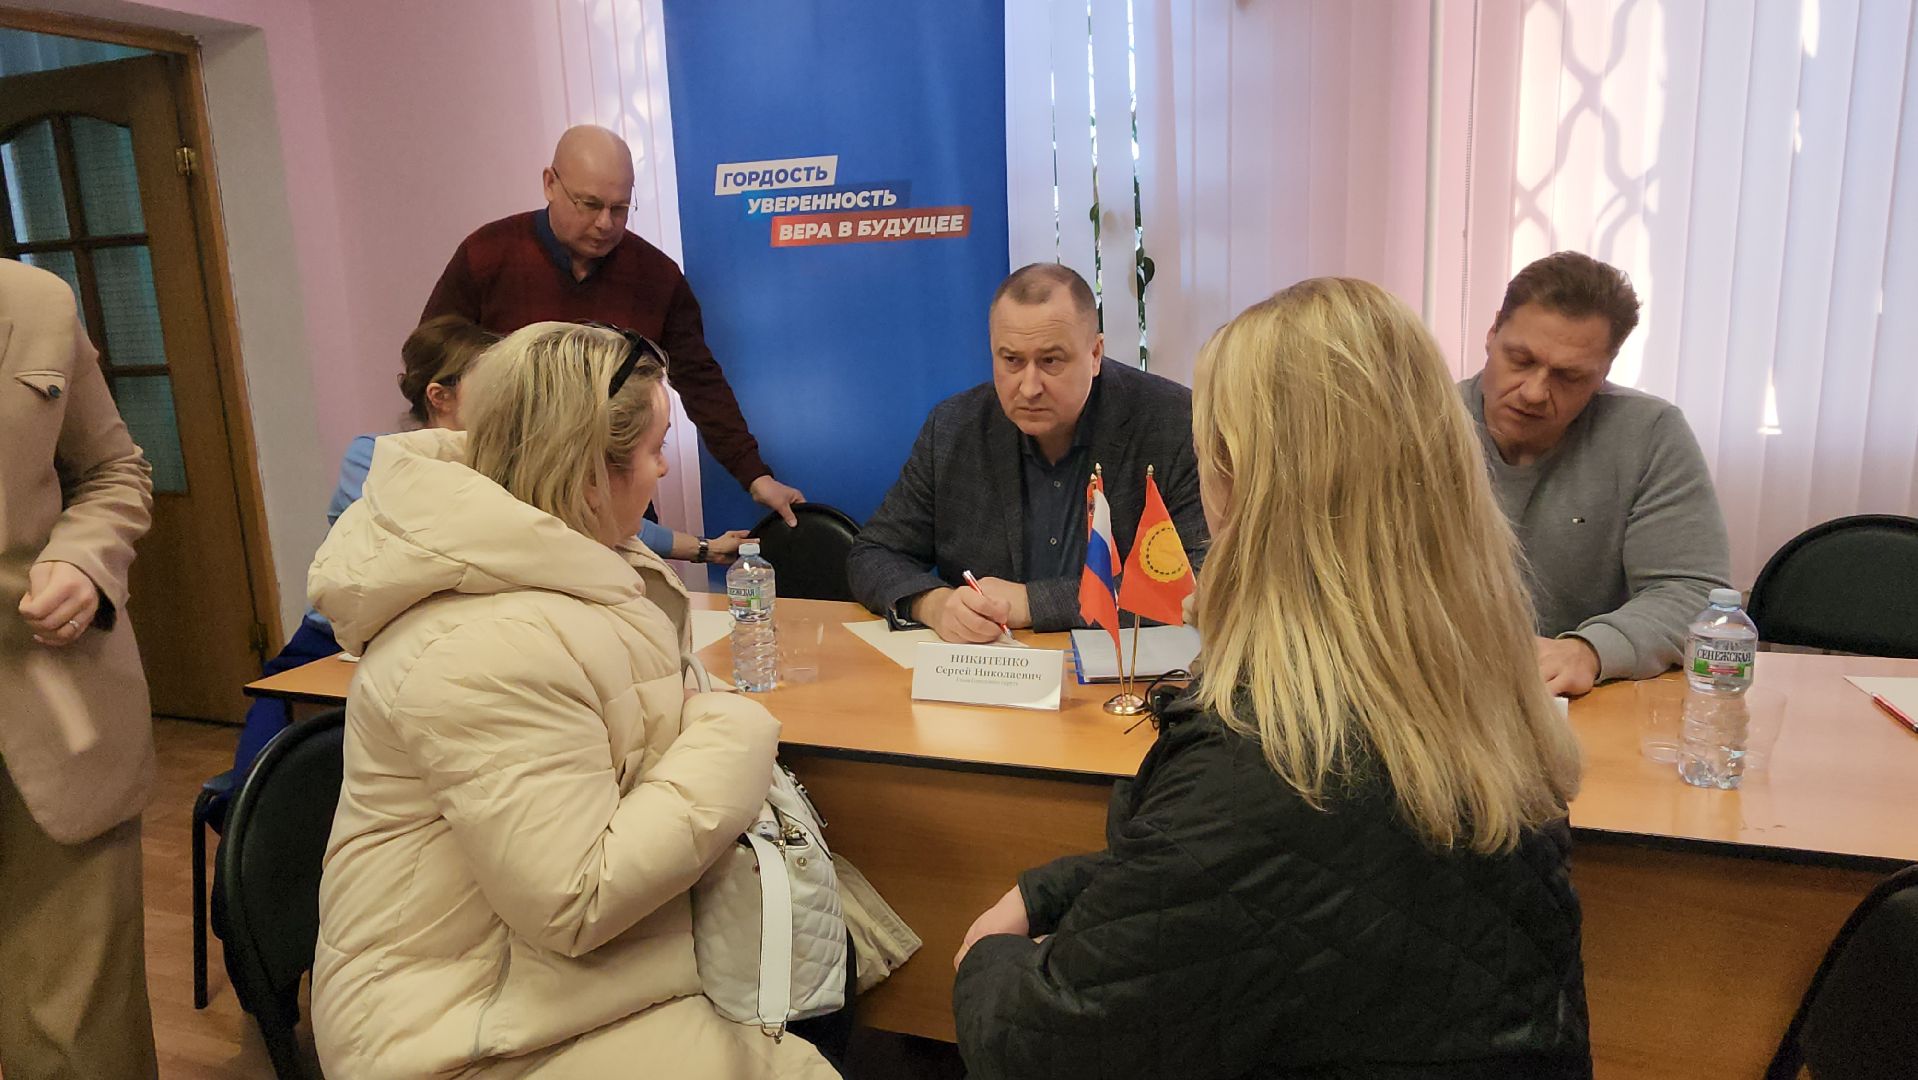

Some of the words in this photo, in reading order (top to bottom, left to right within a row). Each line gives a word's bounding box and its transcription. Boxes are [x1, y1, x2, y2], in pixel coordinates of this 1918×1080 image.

[723, 165, 828, 188] ГОРДОСТЬ
[747, 189, 897, 215] УВЕРЕННОСТЬ
[779, 223, 832, 241] ВЕРА
[838, 221, 852, 237] В
[857, 214, 965, 238] БУДУЩЕЕ
[950, 654, 1029, 667] НИКИТЕНКО
[1696, 648, 1752, 663] СЕНЕЖСКАЯ
[935, 665, 971, 677] Сергей
[974, 668, 1042, 681] Николаевич
